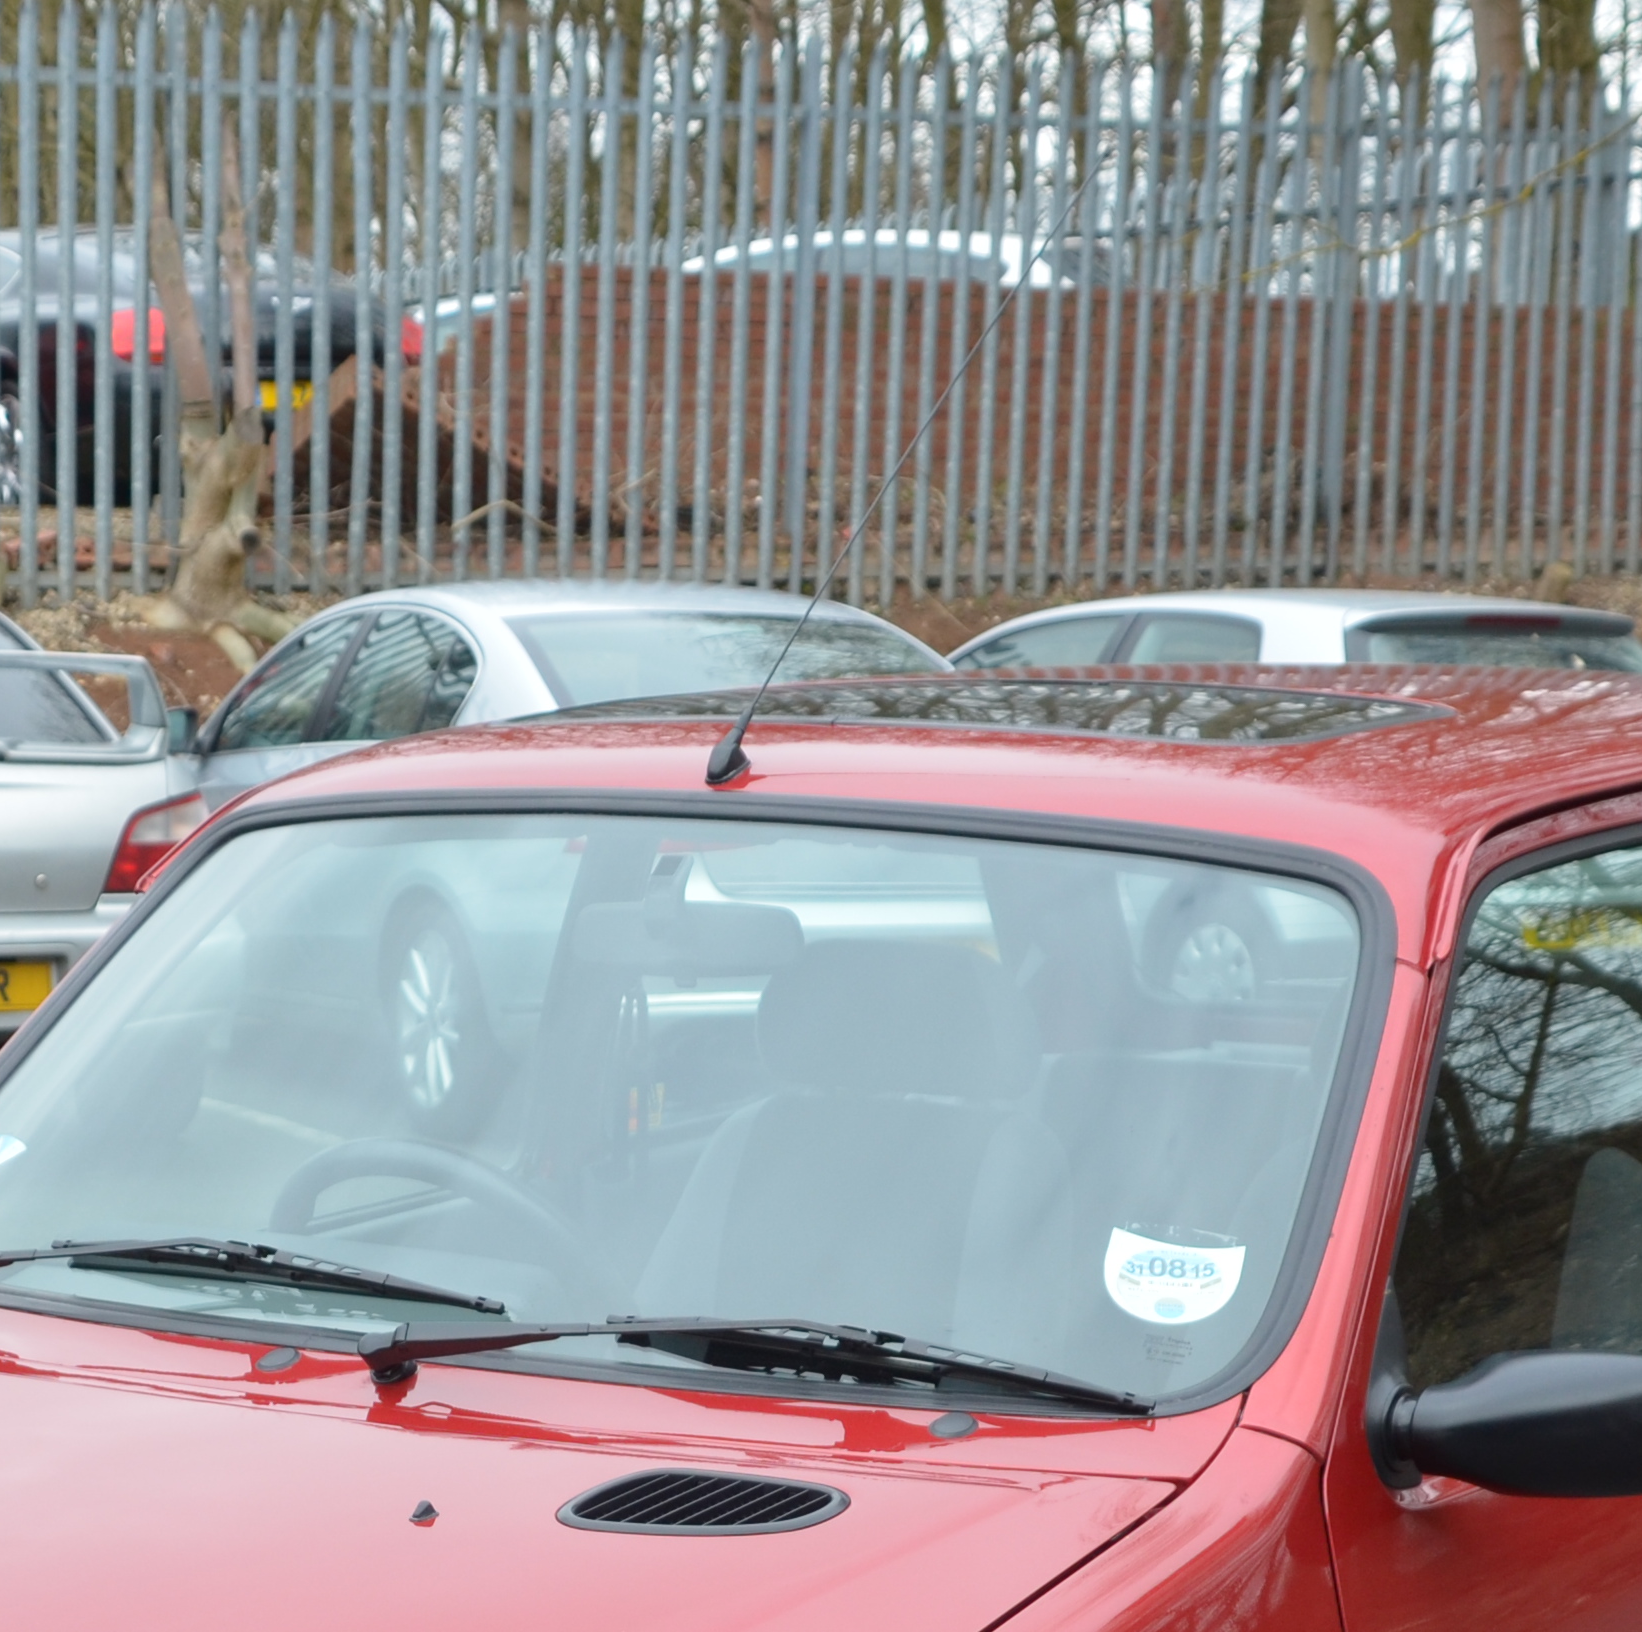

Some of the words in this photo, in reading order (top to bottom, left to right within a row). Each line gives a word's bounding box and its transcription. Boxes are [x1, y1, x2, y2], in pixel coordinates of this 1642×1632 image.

[1125, 1260, 1144, 1276] 31
[1148, 1256, 1187, 1279] 08
[1191, 1262, 1216, 1279] 15
